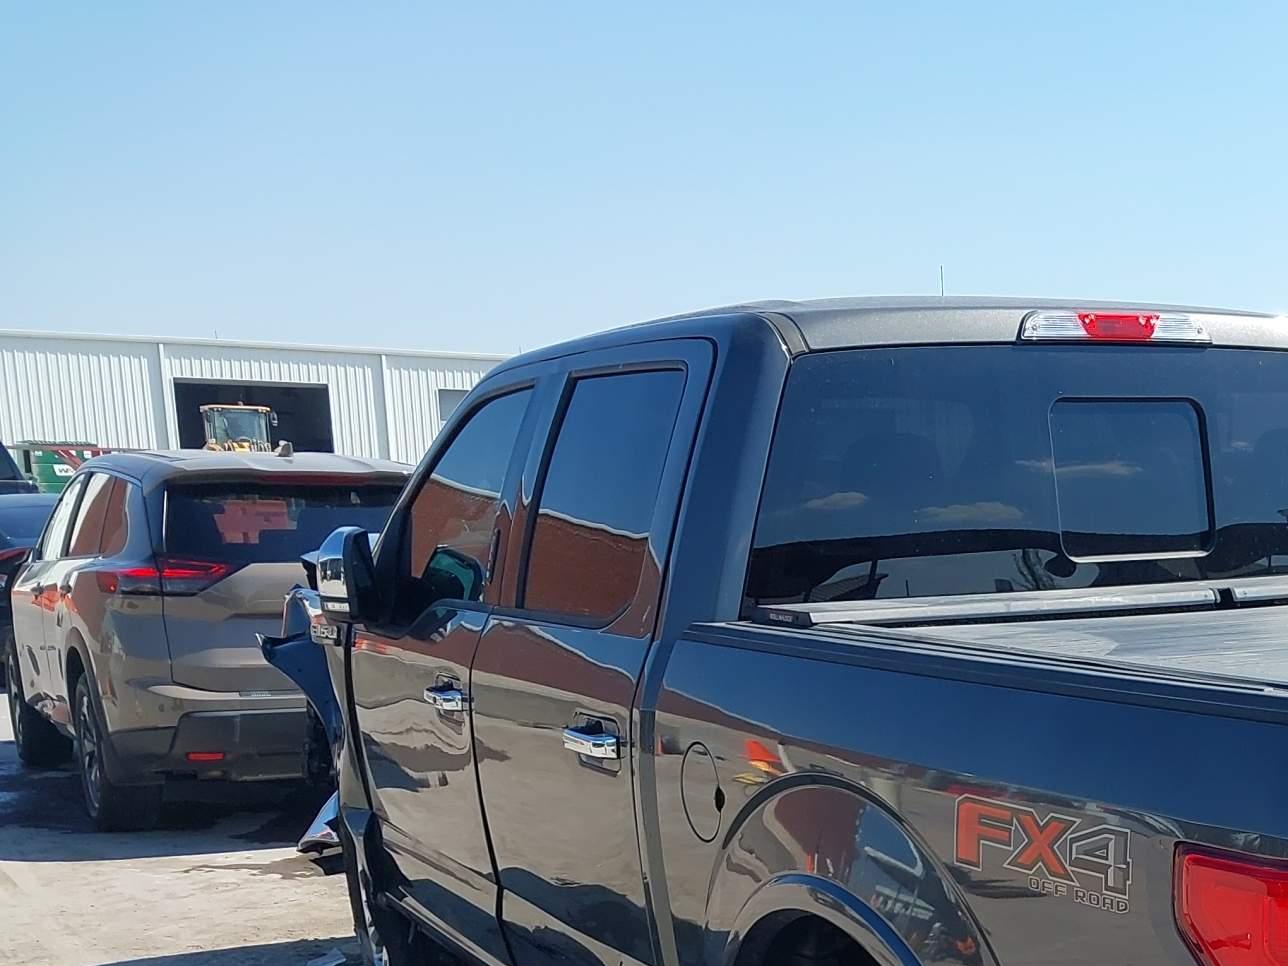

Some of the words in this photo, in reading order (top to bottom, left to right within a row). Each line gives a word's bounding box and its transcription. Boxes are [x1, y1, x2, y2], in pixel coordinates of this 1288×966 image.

[954, 794, 1132, 899] FX4
[1028, 876, 1067, 896] OFF
[1074, 887, 1129, 913] ROAD
